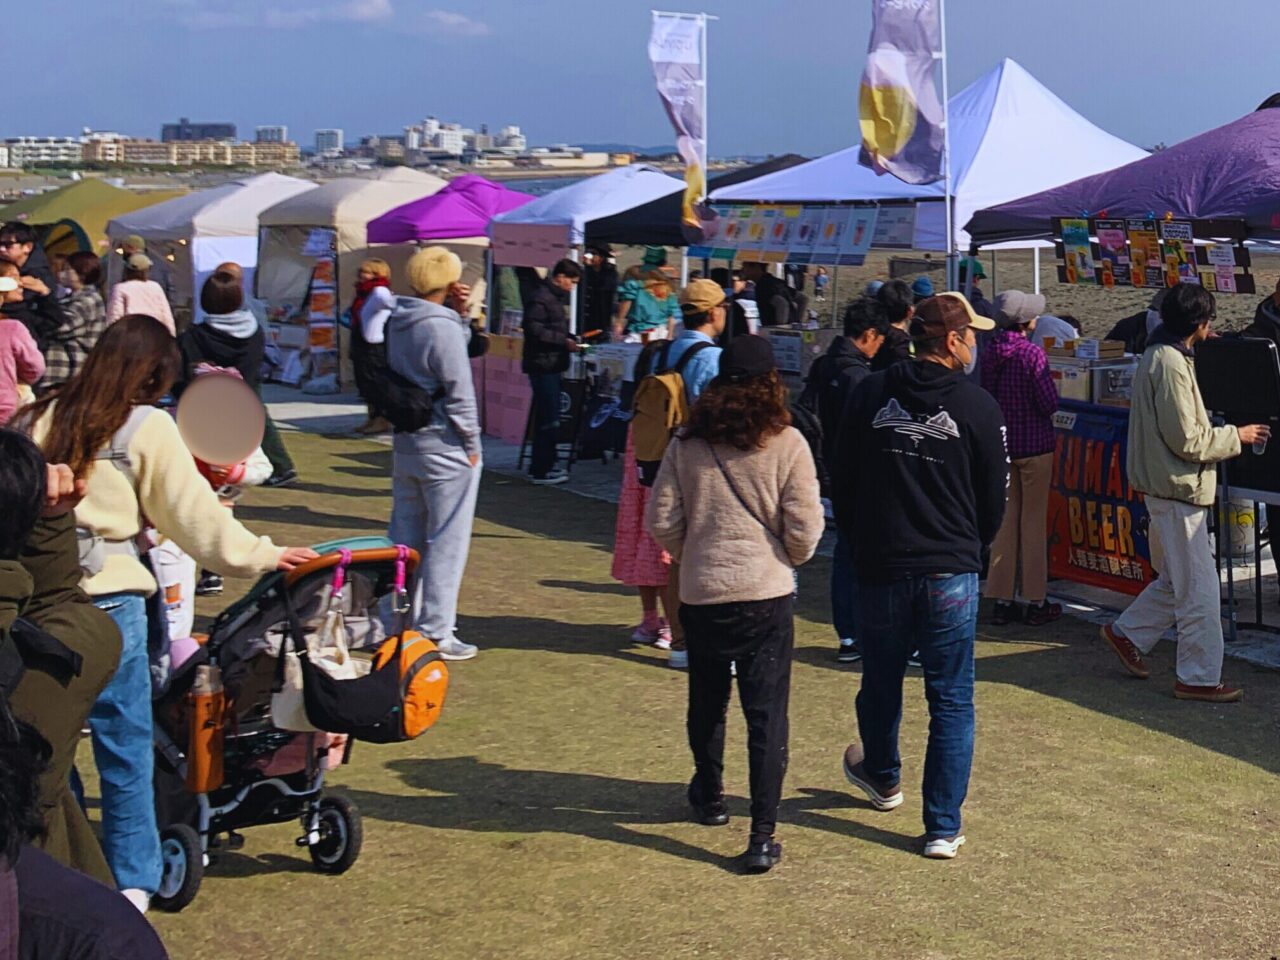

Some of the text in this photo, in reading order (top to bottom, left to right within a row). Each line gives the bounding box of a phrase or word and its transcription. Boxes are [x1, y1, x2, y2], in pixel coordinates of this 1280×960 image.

[1055, 414, 1074, 426] 2021
[1053, 433, 1144, 503] UMA
[1069, 496, 1135, 557] BEER
